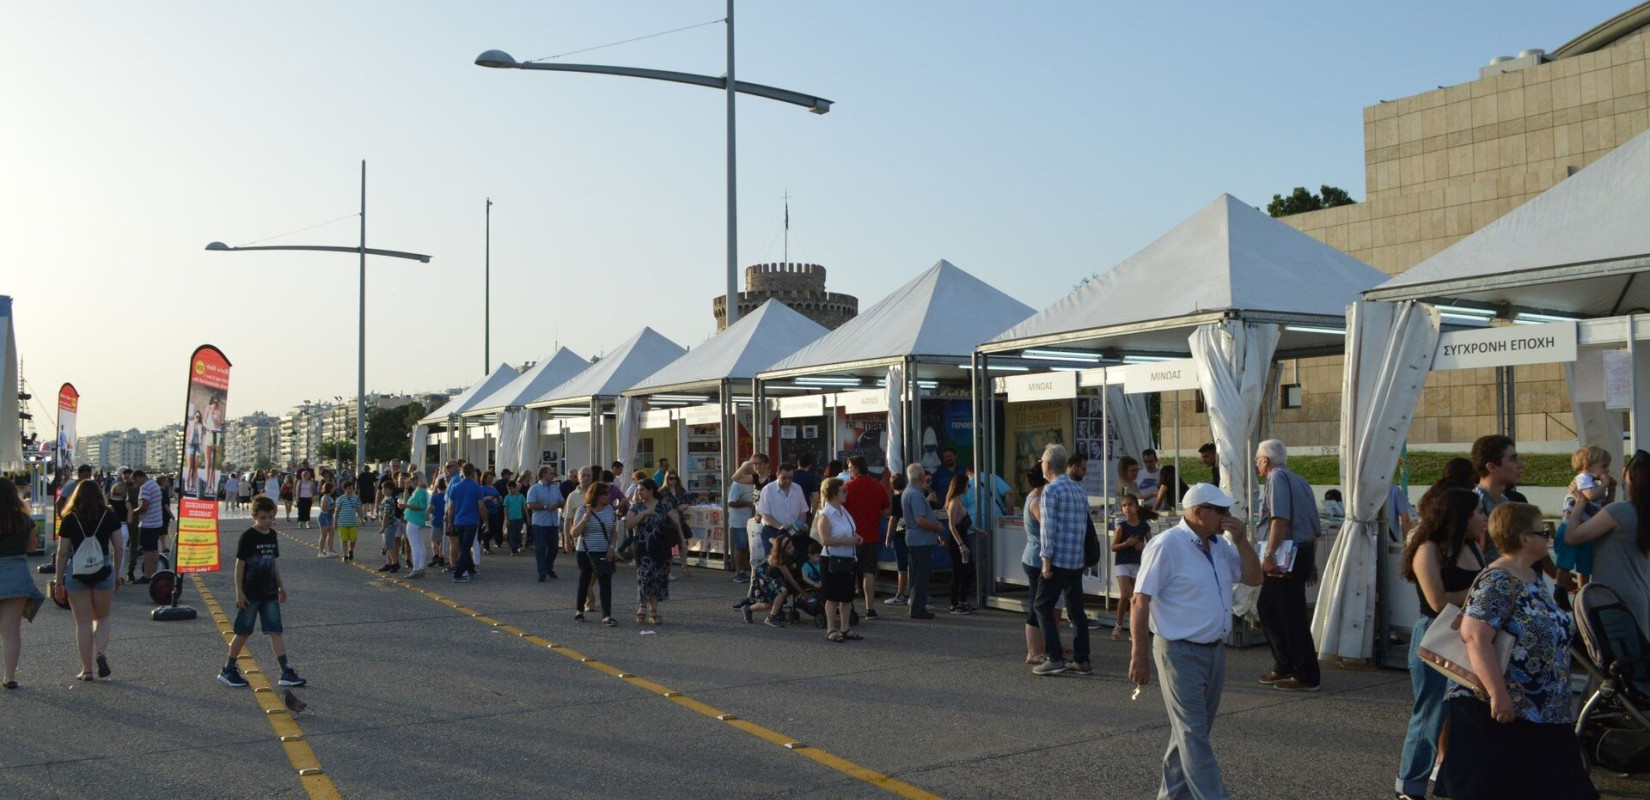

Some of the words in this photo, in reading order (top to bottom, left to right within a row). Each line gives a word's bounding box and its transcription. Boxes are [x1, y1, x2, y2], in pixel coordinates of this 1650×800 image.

[1443, 341, 1507, 356] ΣΥΓΧΡΟΝΗ
[1511, 336, 1555, 351] ΕΠΟΧΗ
[1151, 370, 1182, 381] ΜΙΝΩΑΣ
[1028, 381, 1053, 391] ΜΙΝΩΑΣ
